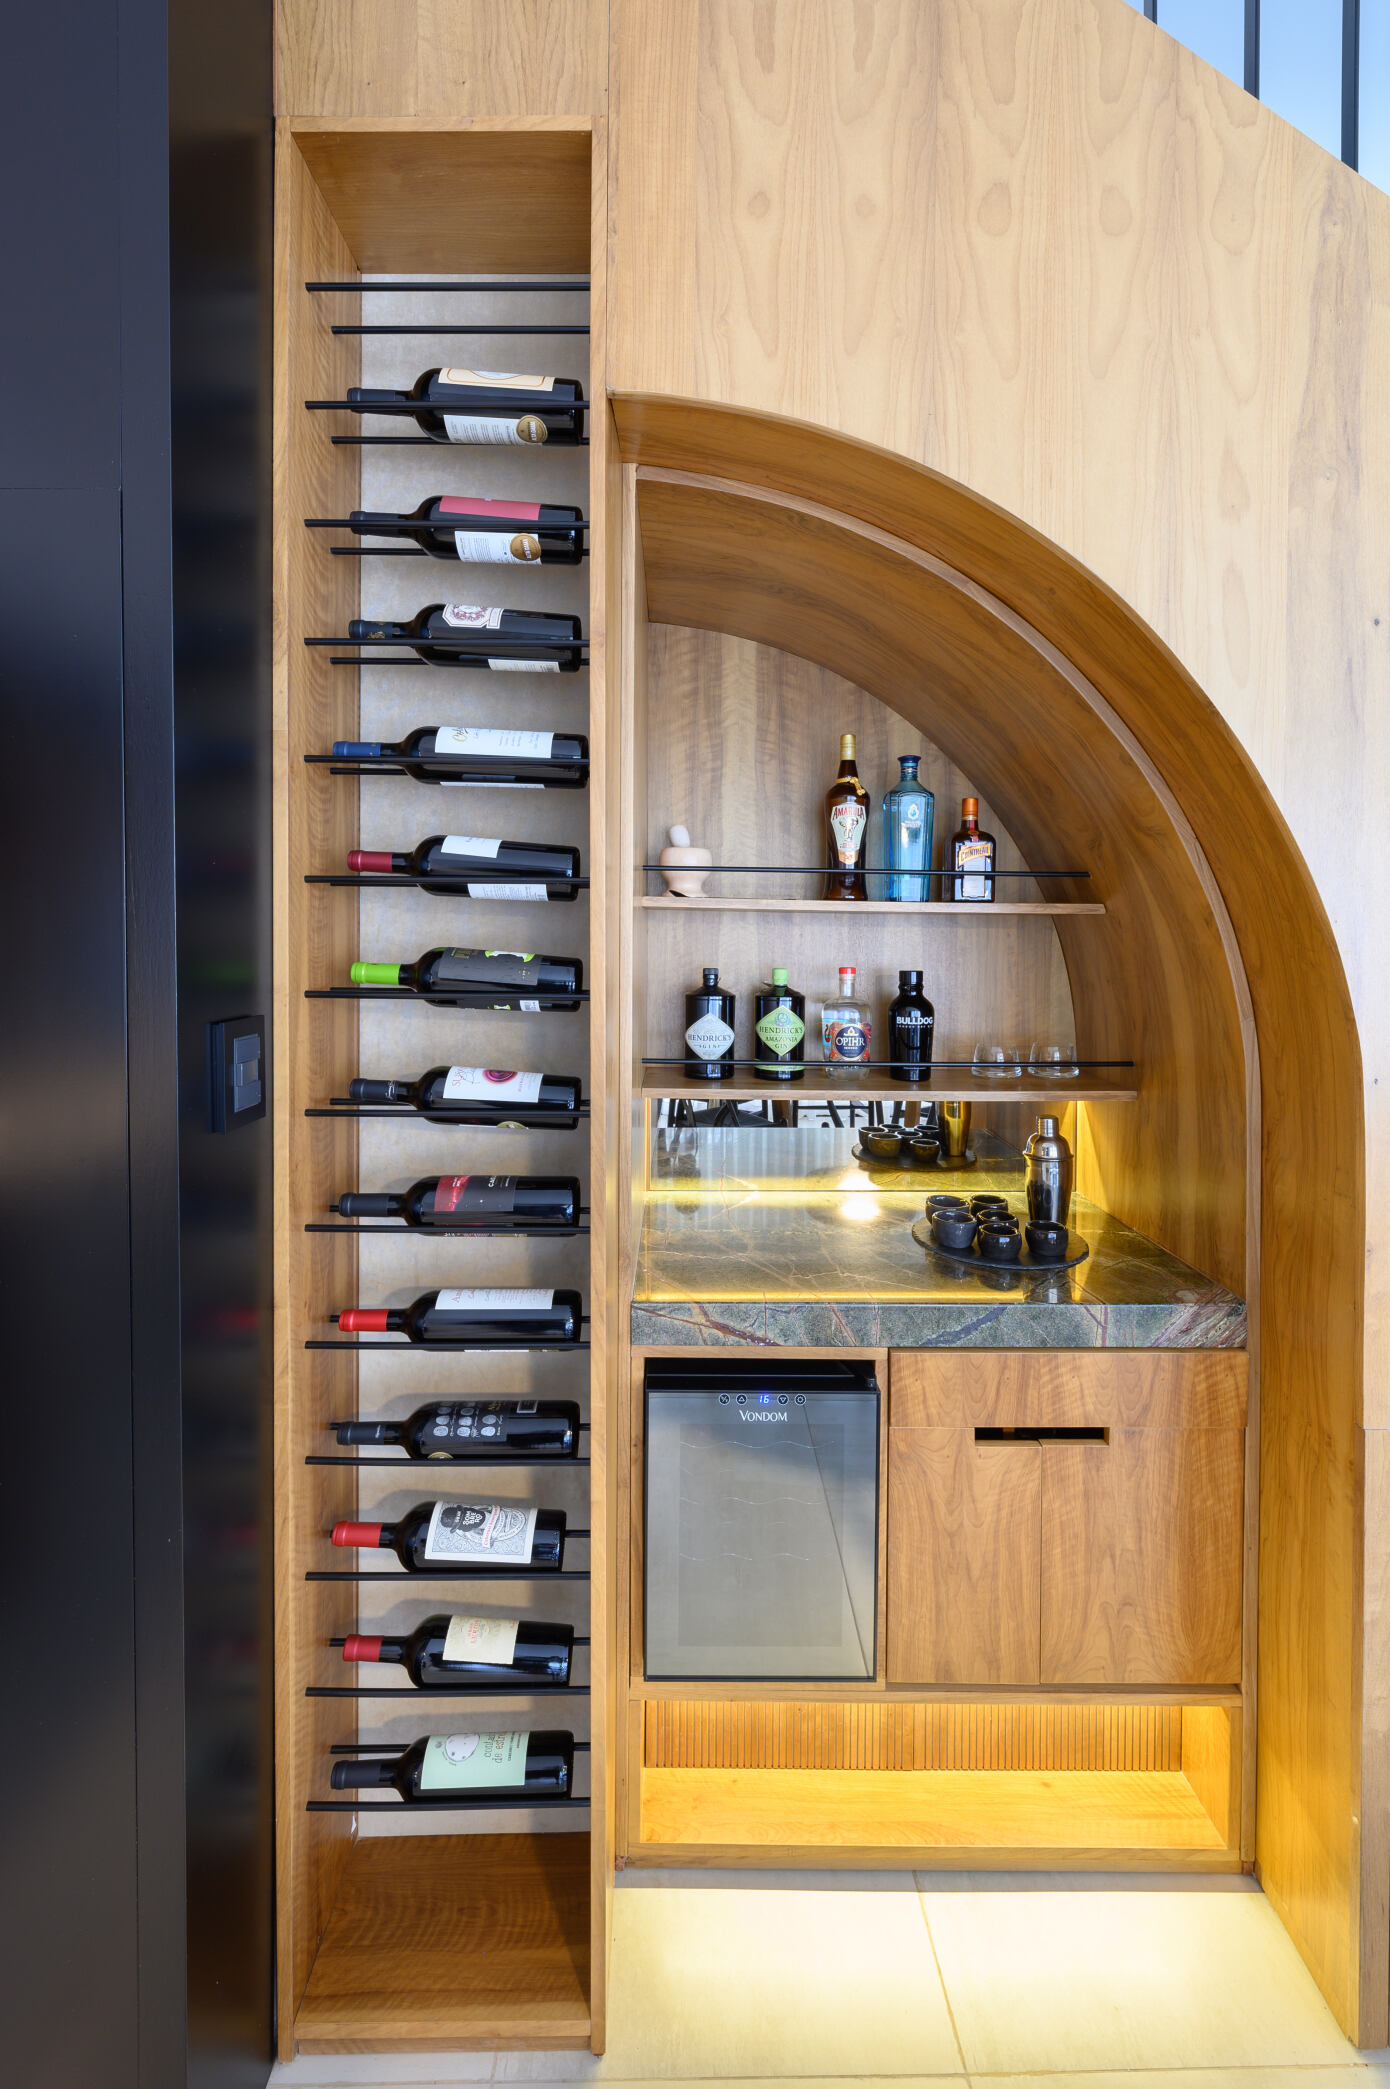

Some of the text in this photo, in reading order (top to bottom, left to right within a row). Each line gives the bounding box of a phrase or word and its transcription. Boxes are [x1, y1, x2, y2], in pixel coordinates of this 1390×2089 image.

[832, 806, 865, 821] AMARULA
[960, 845, 989, 862] COINTREAU
[896, 1016, 934, 1025] BULLDOG
[835, 1036, 865, 1047] OPIHR
[759, 1395, 769, 1404] 16
[738, 1409, 788, 1422] VONDOM
